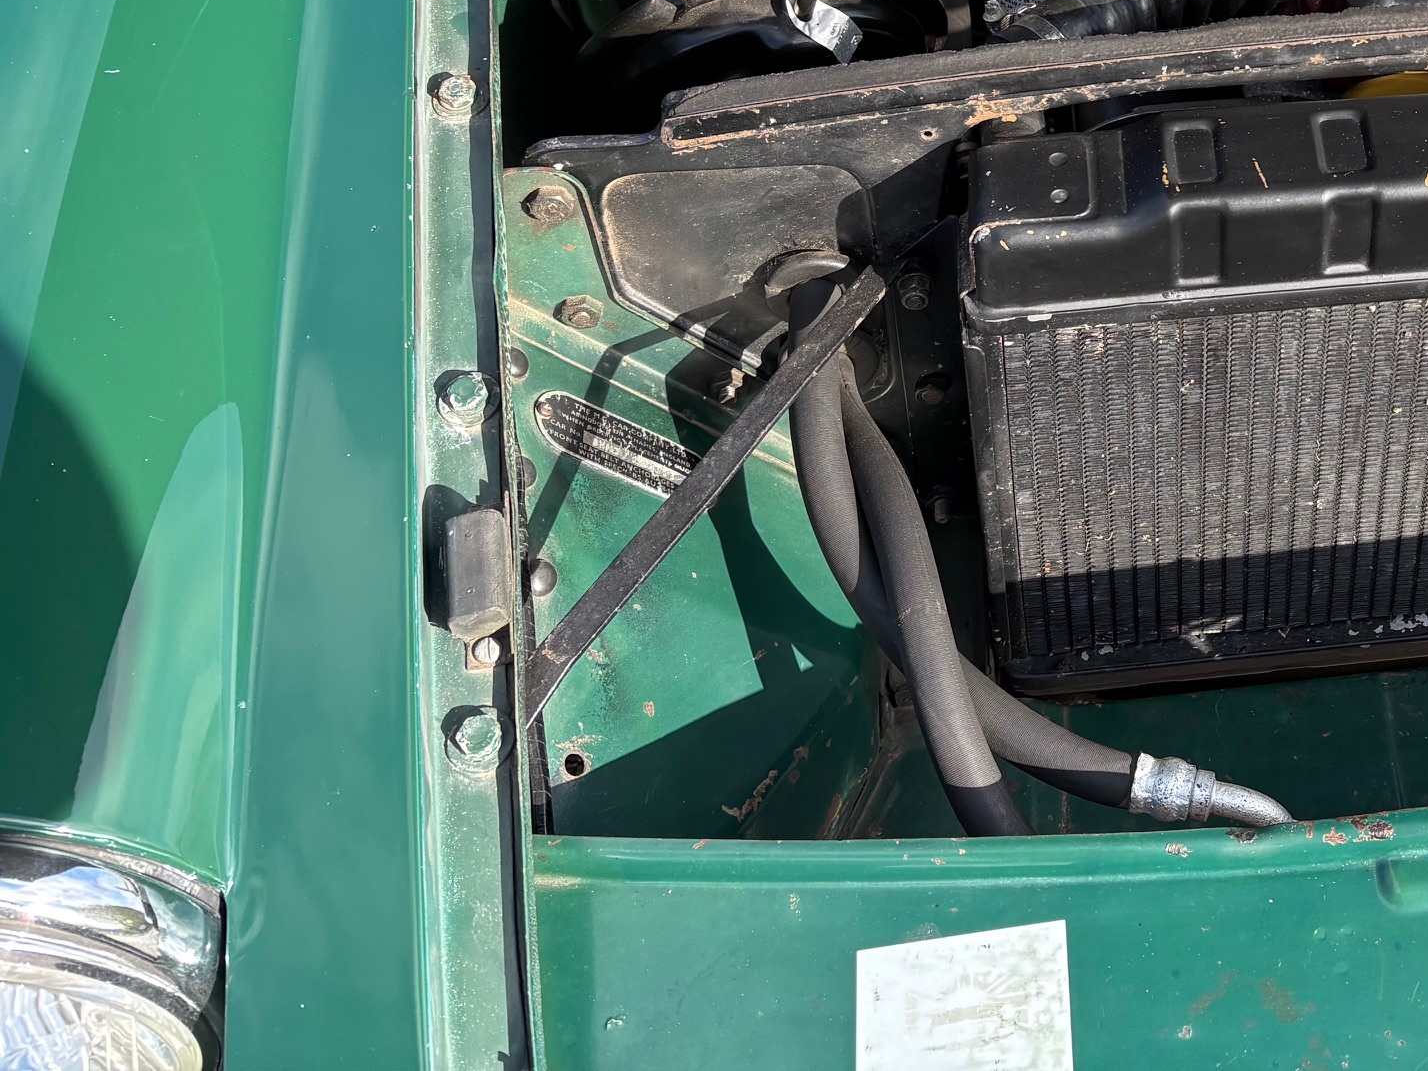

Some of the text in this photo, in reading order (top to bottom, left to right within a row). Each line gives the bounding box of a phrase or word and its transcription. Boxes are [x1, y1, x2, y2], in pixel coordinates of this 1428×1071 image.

[550, 419, 566, 430] CAR
[561, 412, 585, 427] WHEN
[550, 429, 578, 445] FRONT
[579, 442, 599, 455] SEAT
[600, 451, 619, 464] BELT
[579, 448, 601, 463] WITH
